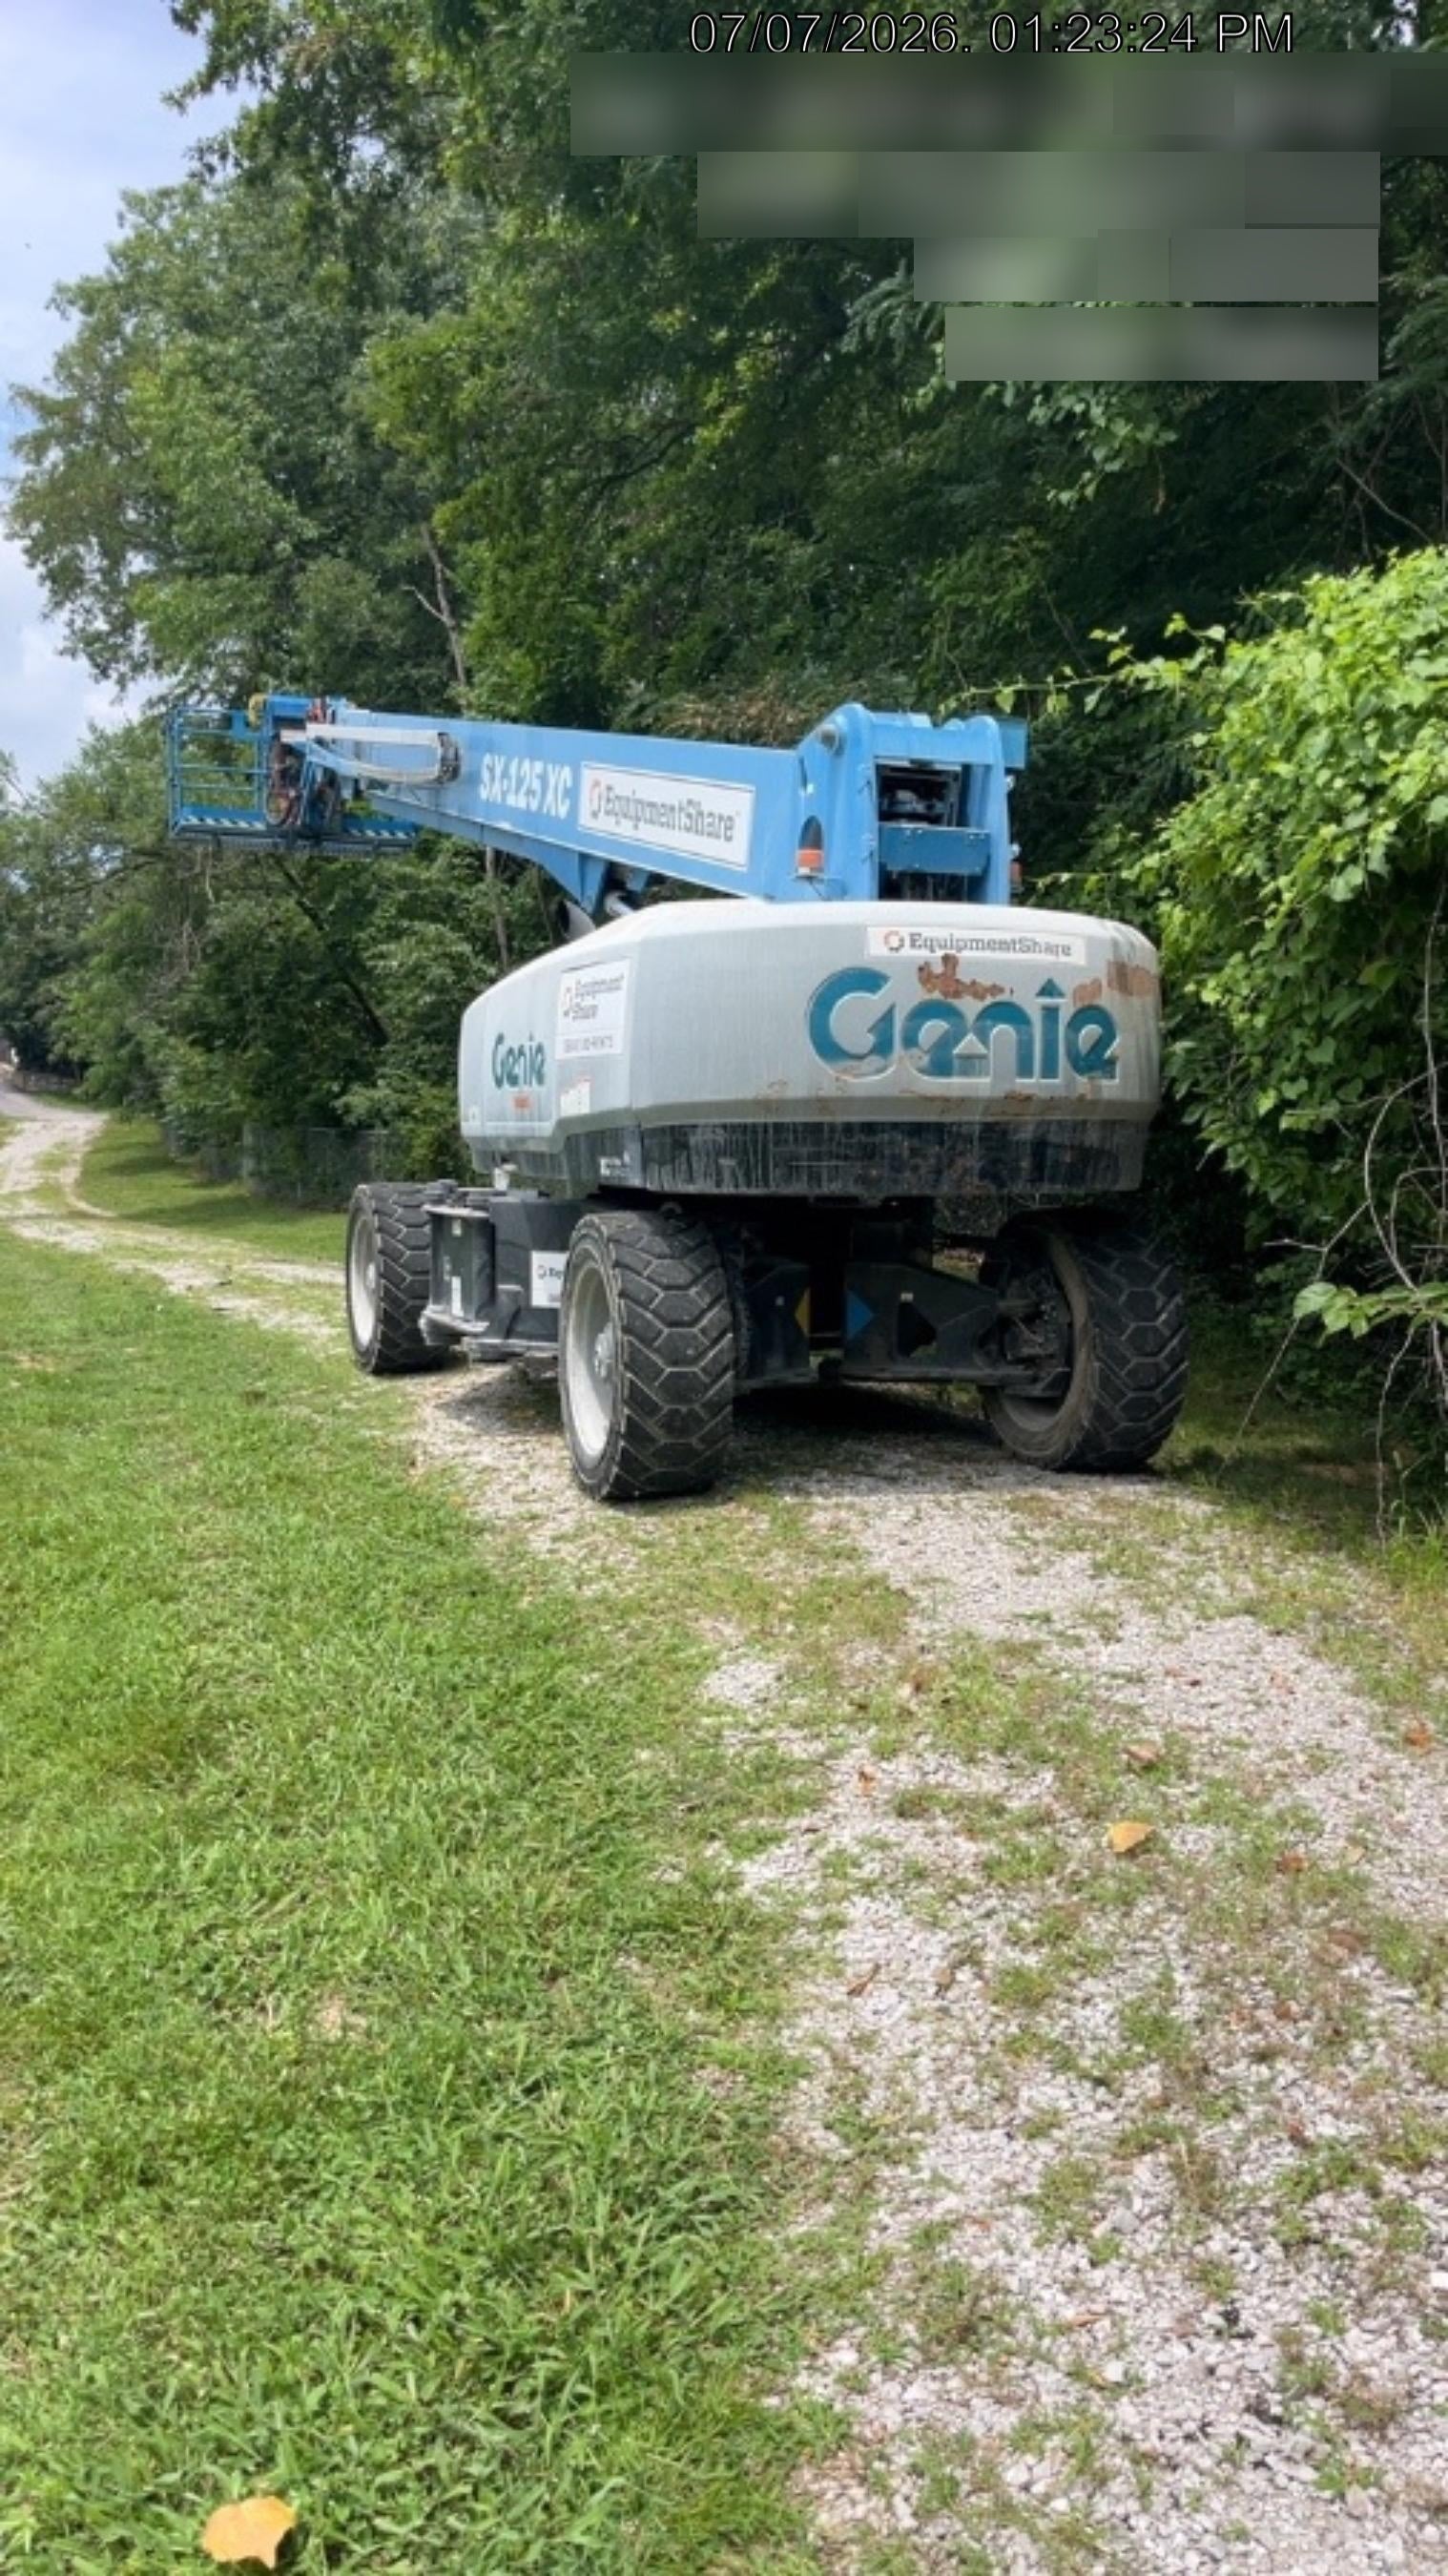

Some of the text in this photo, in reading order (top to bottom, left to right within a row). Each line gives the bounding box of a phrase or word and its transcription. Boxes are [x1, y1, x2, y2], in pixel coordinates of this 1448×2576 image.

[479, 753, 571, 819] SX-125 XC
[603, 784, 735, 841] EquipmentShare
[908, 933, 1072, 958] EquipmentShare
[807, 966, 1121, 1084] Genie
[492, 1031, 545, 1089] Genie
